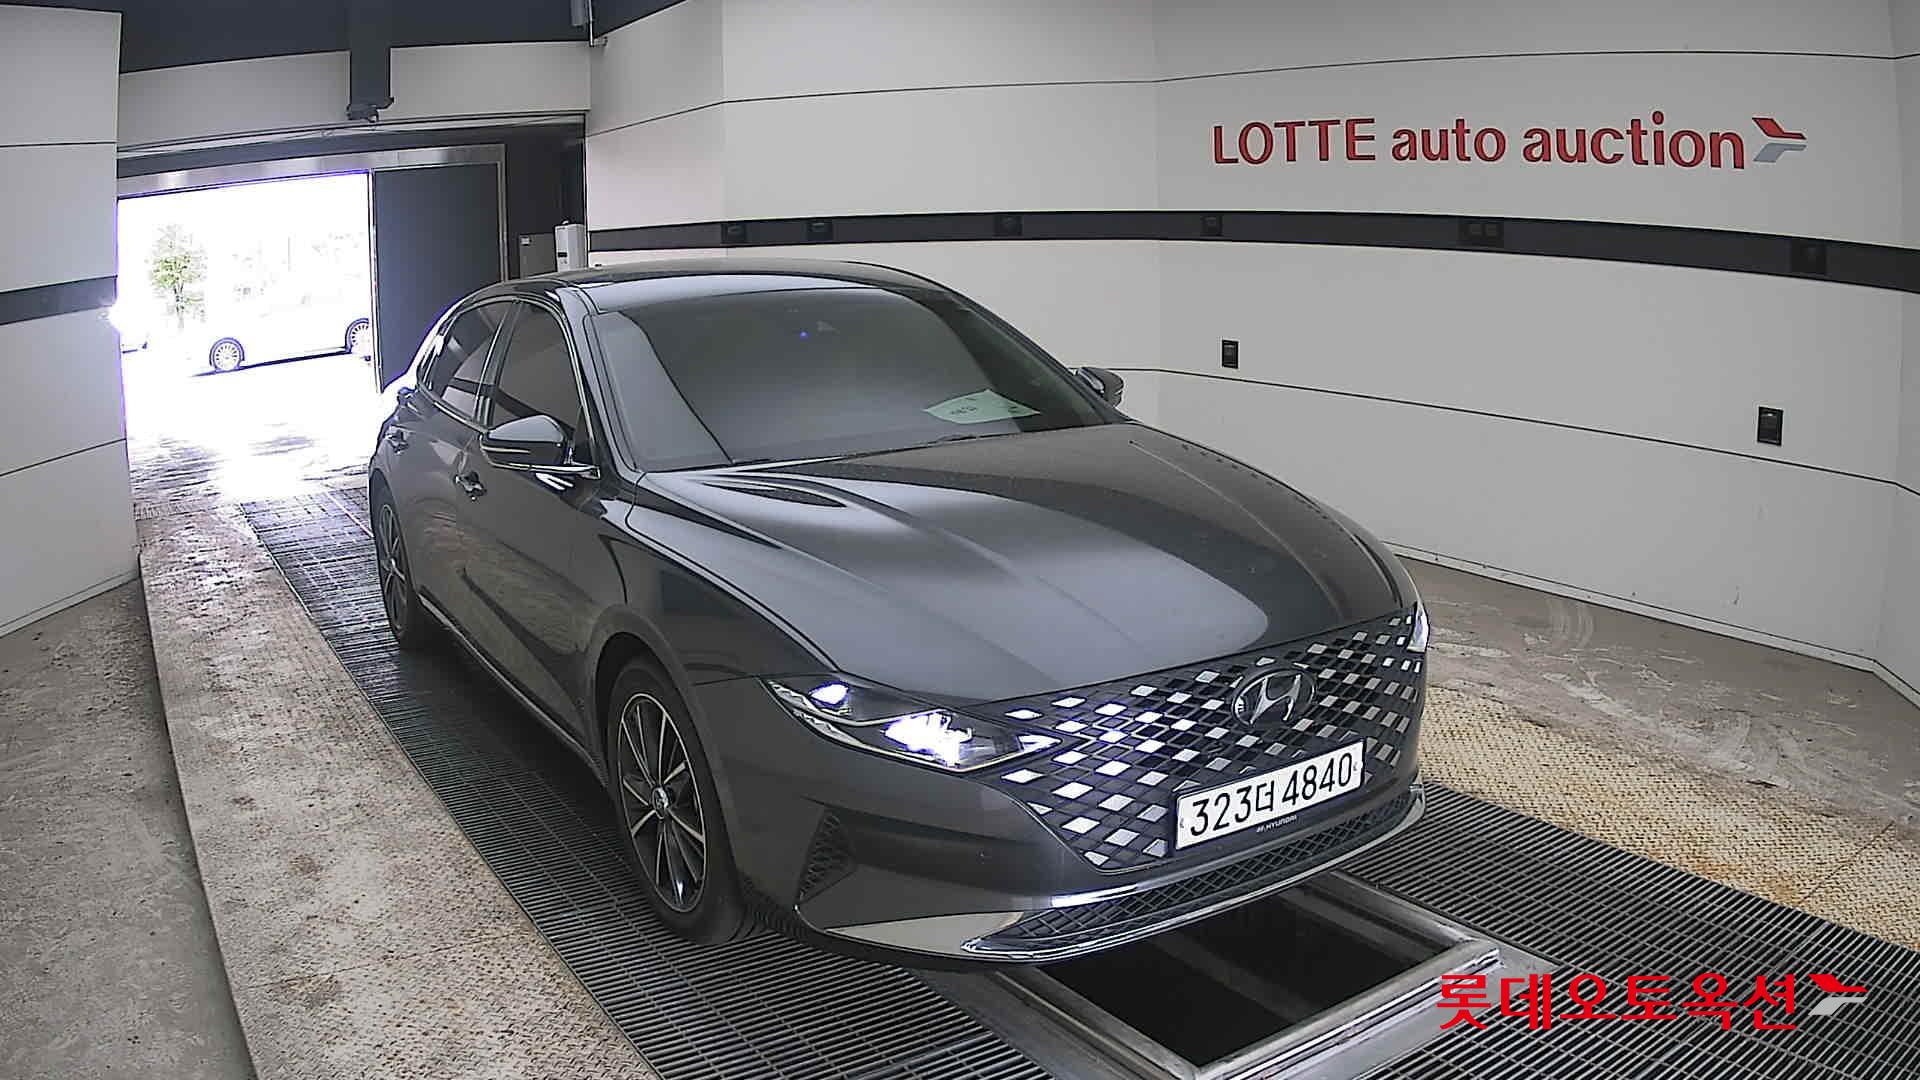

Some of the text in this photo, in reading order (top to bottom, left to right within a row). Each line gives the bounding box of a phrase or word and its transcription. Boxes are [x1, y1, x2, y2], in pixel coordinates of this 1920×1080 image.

[1213, 110, 1746, 170] LOTTE auto auction
[1190, 752, 1353, 837] 323더 4840
